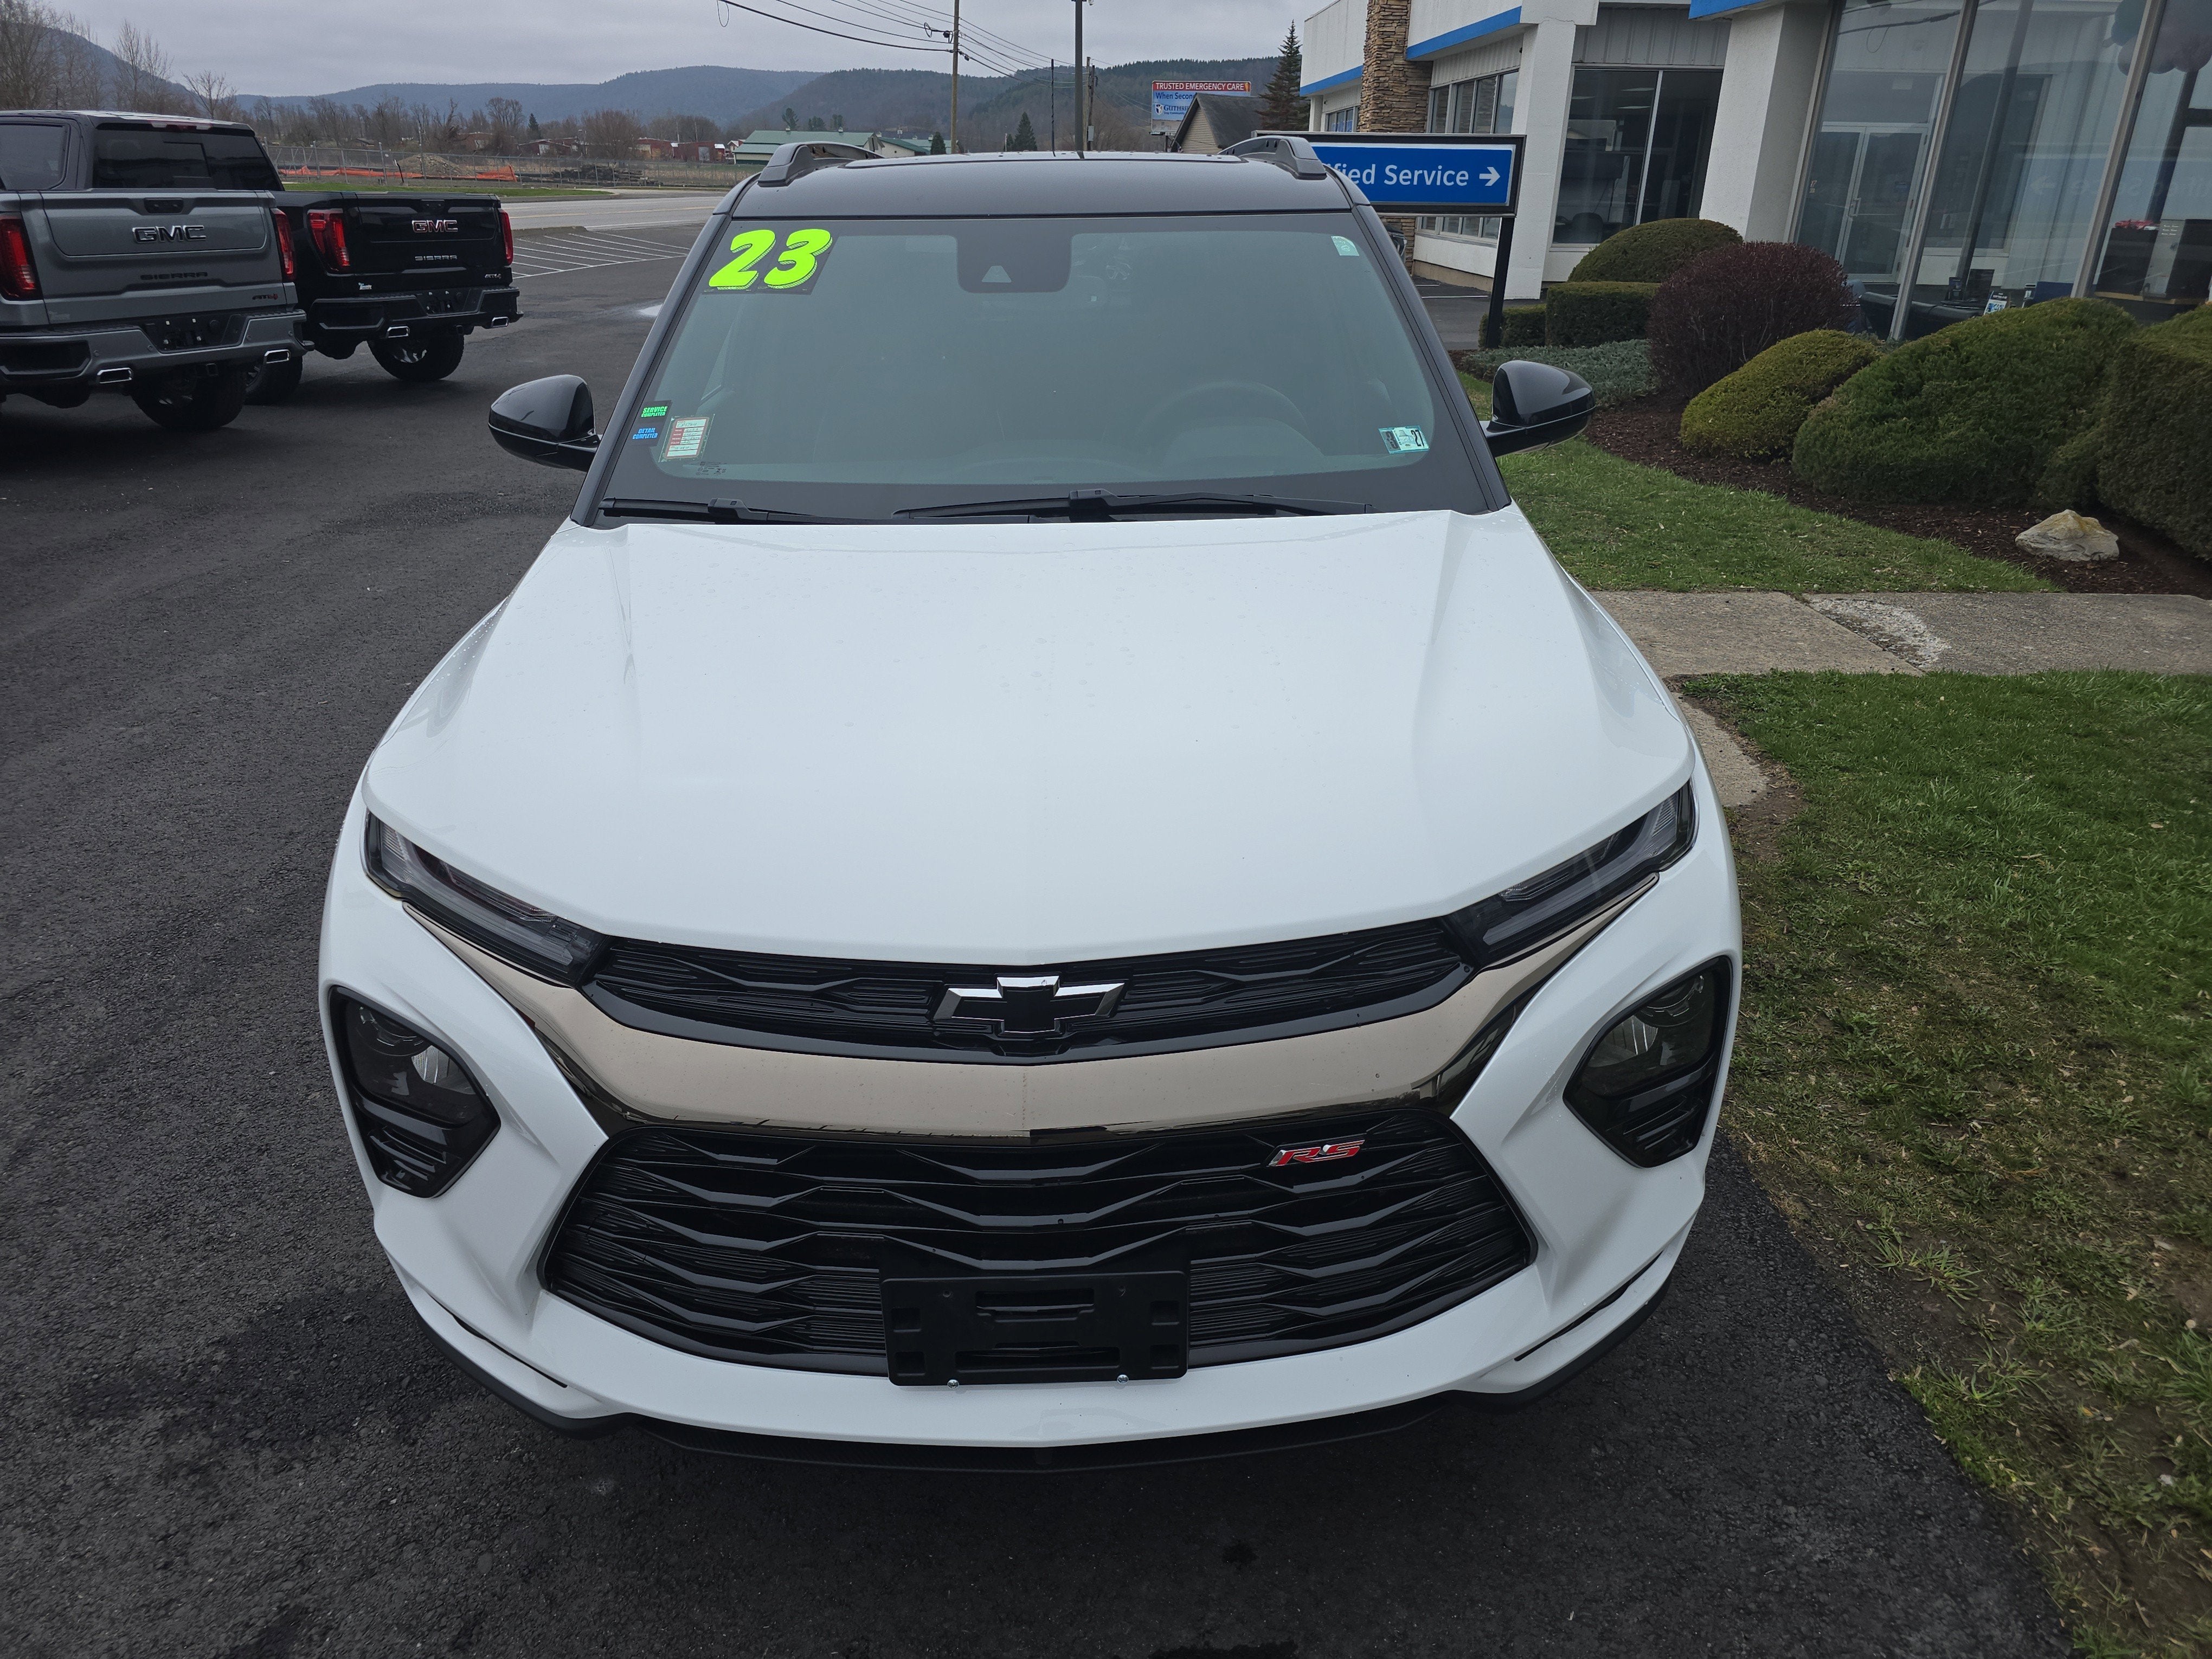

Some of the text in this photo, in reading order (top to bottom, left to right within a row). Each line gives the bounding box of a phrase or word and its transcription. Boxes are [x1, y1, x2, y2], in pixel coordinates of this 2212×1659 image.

[1185, 82, 1226, 91] EMERGENCY
[1384, 165, 1469, 186] Service
[132, 225, 207, 243] GMC
[411, 220, 458, 233] GMC
[709, 229, 833, 290] 23
[140, 272, 208, 280] SIERRA
[1411, 429, 1425, 447] 27
[1268, 1139, 1365, 1167] RS
